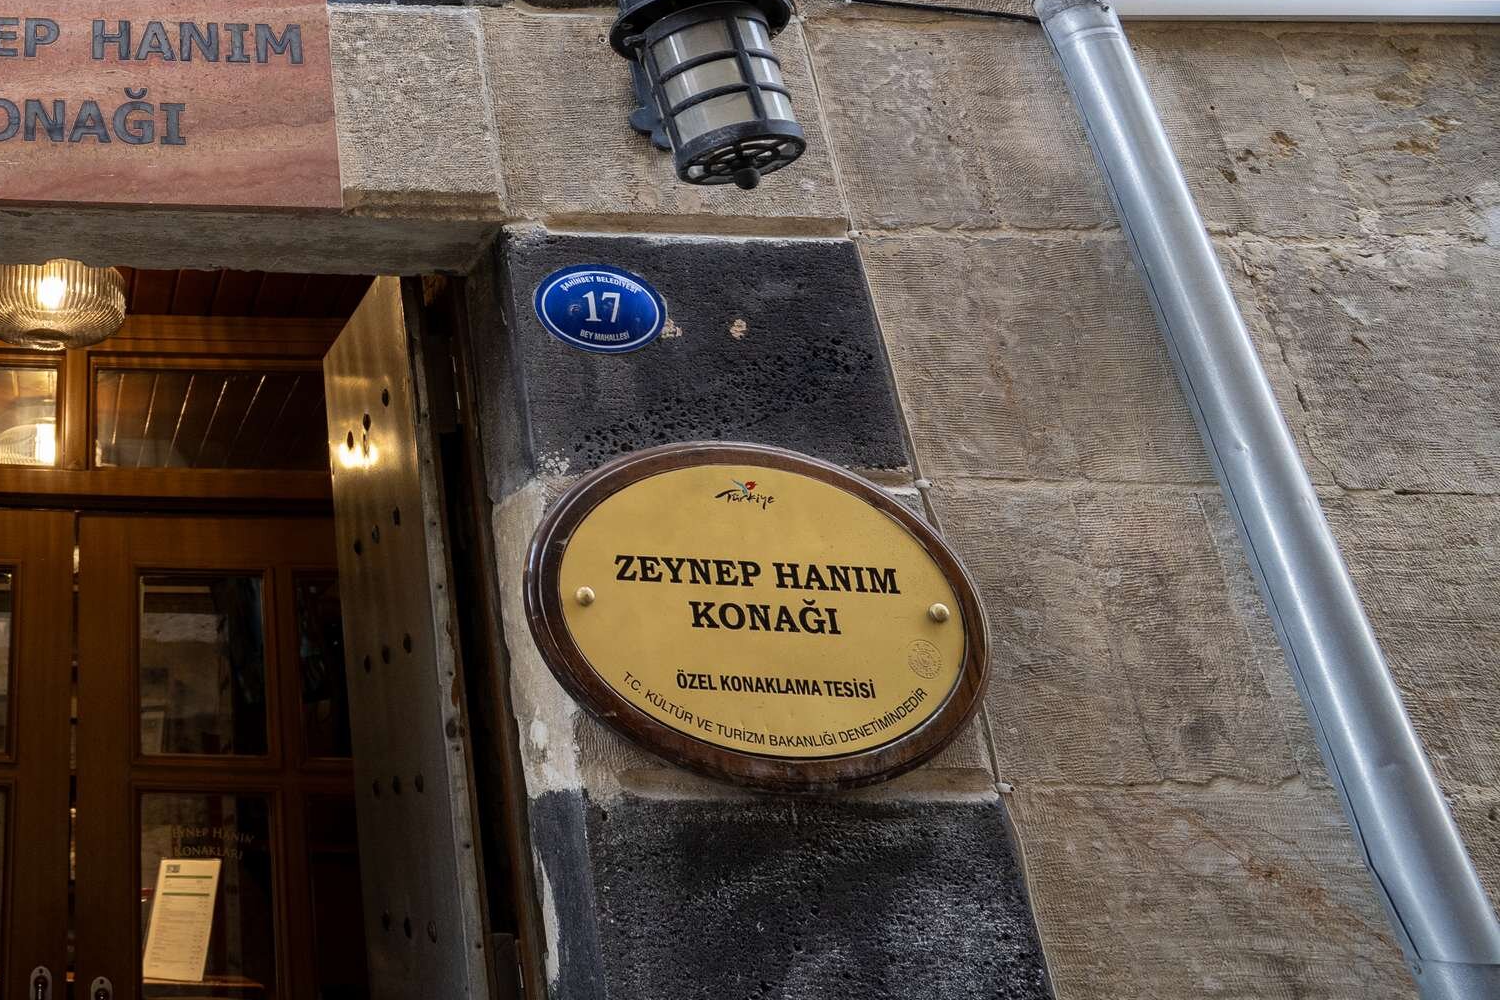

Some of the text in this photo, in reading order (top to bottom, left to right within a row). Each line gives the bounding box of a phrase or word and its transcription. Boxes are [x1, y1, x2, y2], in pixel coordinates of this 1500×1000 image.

[90, 18, 305, 65] HANIM
[582, 290, 621, 323] 17
[714, 488, 776, 511] Türkiye
[614, 554, 901, 595] ZEYNEP HANIM
[688, 598, 842, 635] KONAĞI
[676, 668, 877, 699] ÖZEL KONAKLAMA TESİSİ
[623, 671, 928, 748] T.C. KÜLTÜR VE TURİZM BAKANLIĞI DENETİMİNDEDİR
